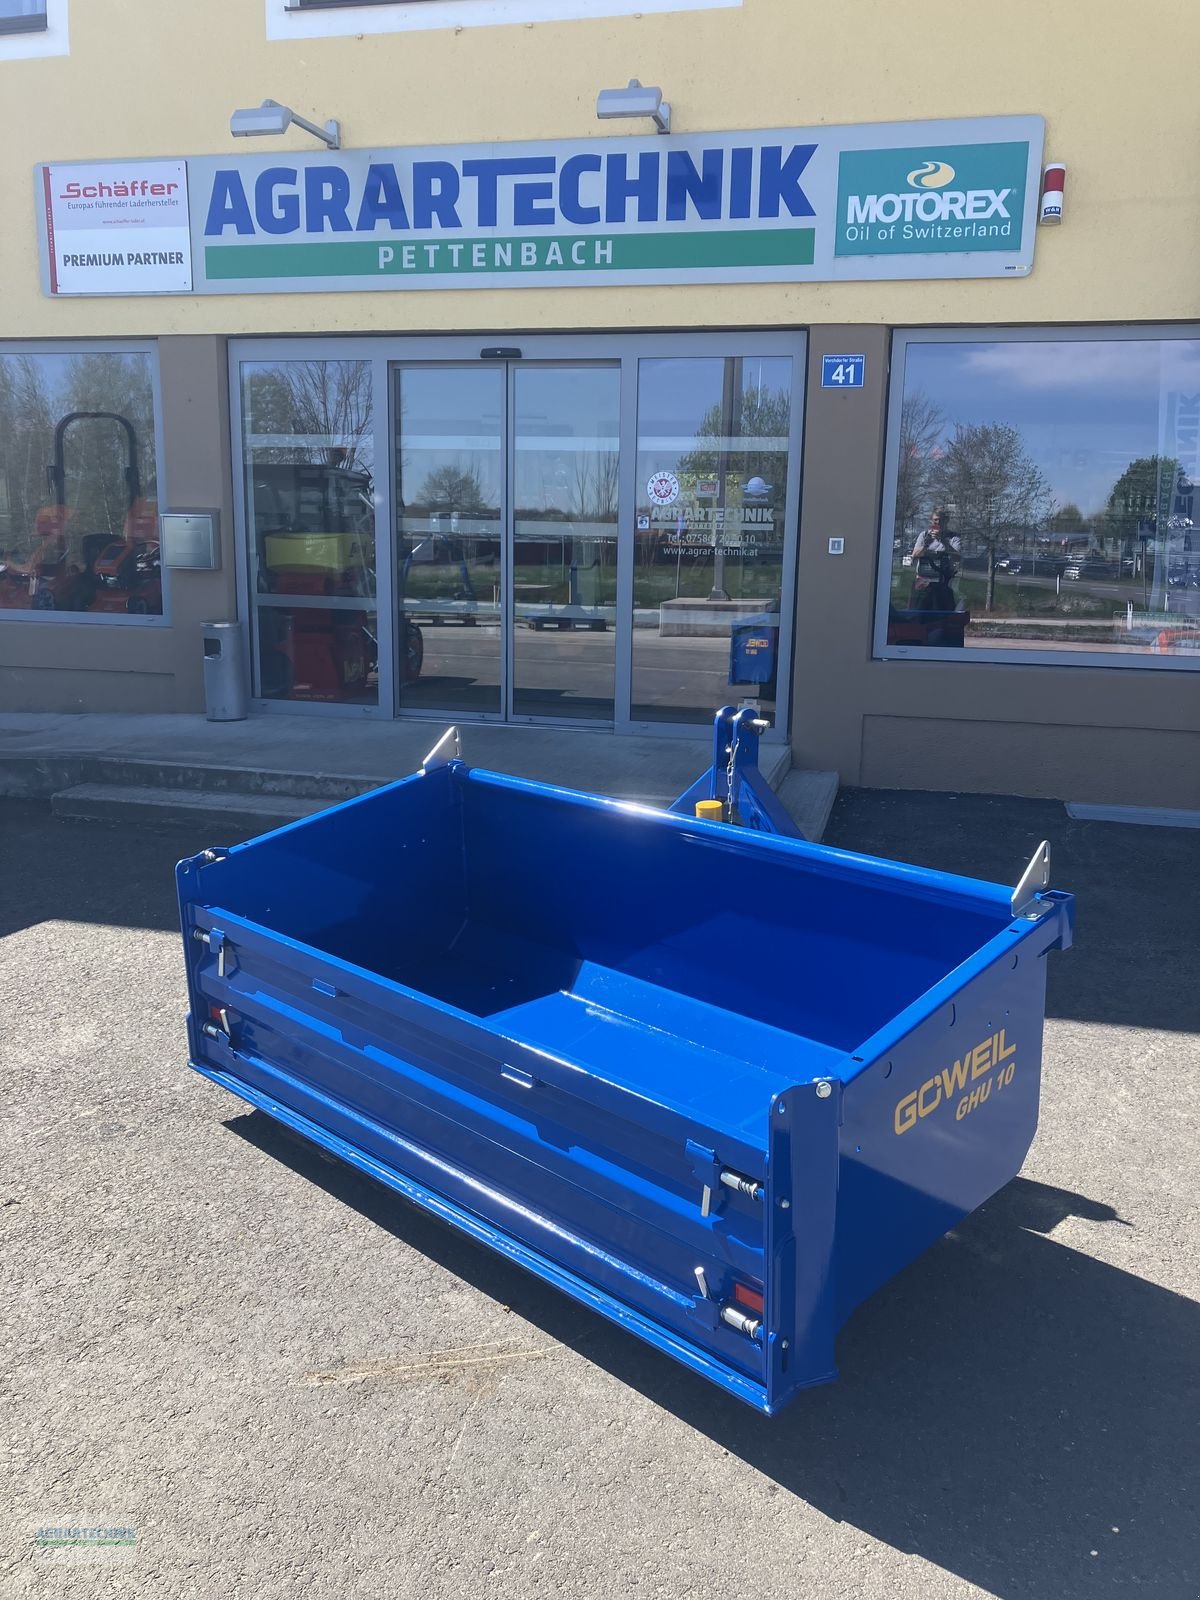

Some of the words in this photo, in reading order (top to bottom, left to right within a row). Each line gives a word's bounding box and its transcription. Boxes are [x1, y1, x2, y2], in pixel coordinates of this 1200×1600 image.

[60, 180, 178, 198] Schäffer
[204, 143, 819, 236] AGRARTECHNIK
[67, 201, 94, 211] Europas
[129, 199, 179, 208] Laderhersteller
[847, 188, 1011, 224] MOTOREX
[846, 226, 870, 241] Oil
[877, 224, 896, 240] of
[902, 221, 1011, 239] Switzerland
[63, 253, 125, 267] PREMIUM
[127, 251, 184, 265] PARTNER
[378, 239, 613, 269] PETTENBACH
[831, 364, 855, 384] 41
[745, 535, 756, 544] 10
[663, 547, 758, 557] www.agrar-technik.at
[955, 1078, 992, 1121] GHU
[997, 1062, 1015, 1090] 10
